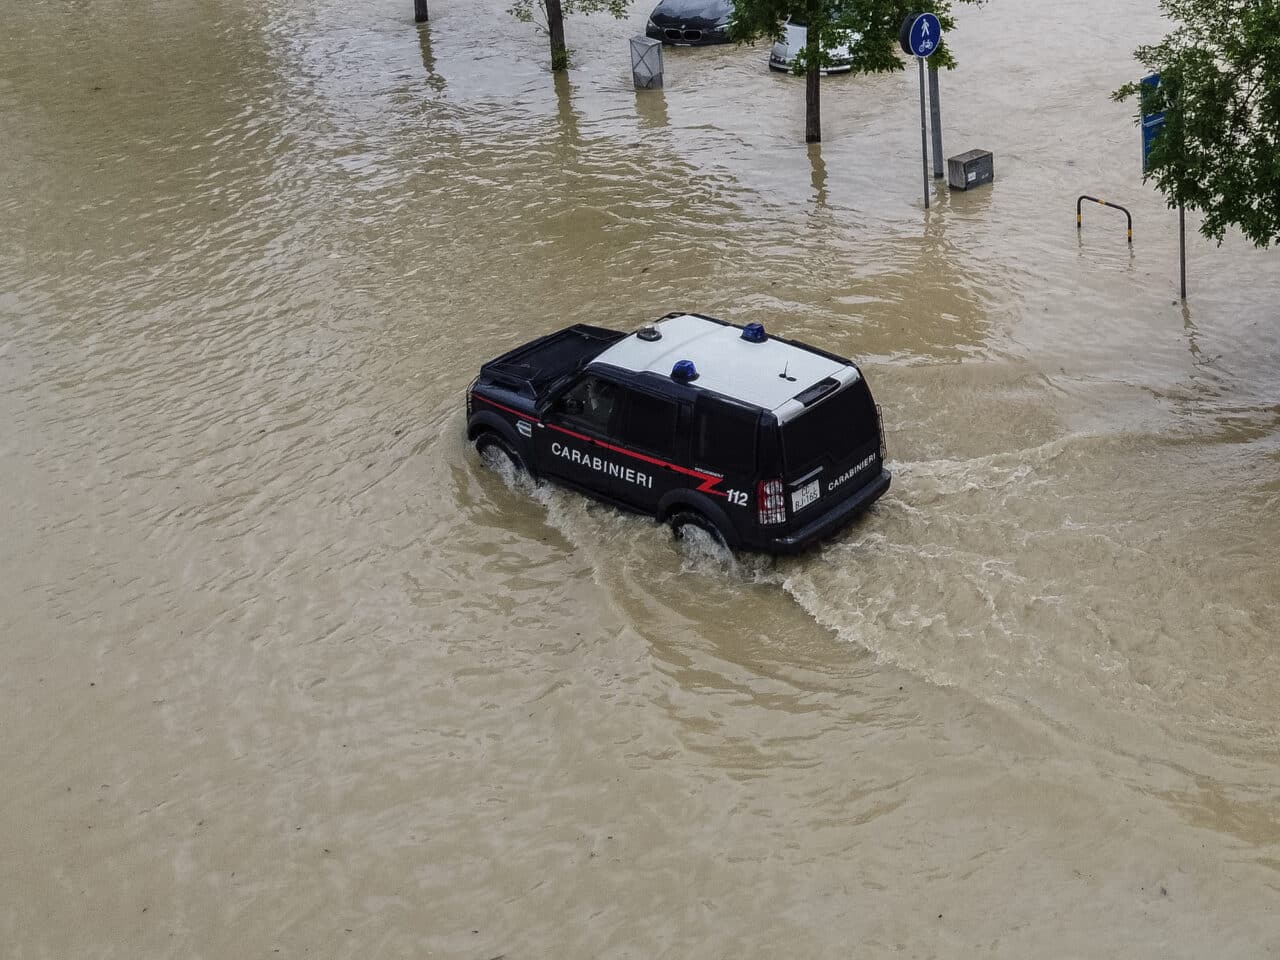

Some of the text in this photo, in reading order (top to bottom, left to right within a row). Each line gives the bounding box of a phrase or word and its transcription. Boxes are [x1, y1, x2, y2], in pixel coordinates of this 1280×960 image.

[551, 442, 653, 489] CARABINIERI
[827, 452, 876, 491] CARABINIERI
[726, 488, 749, 507] 112
